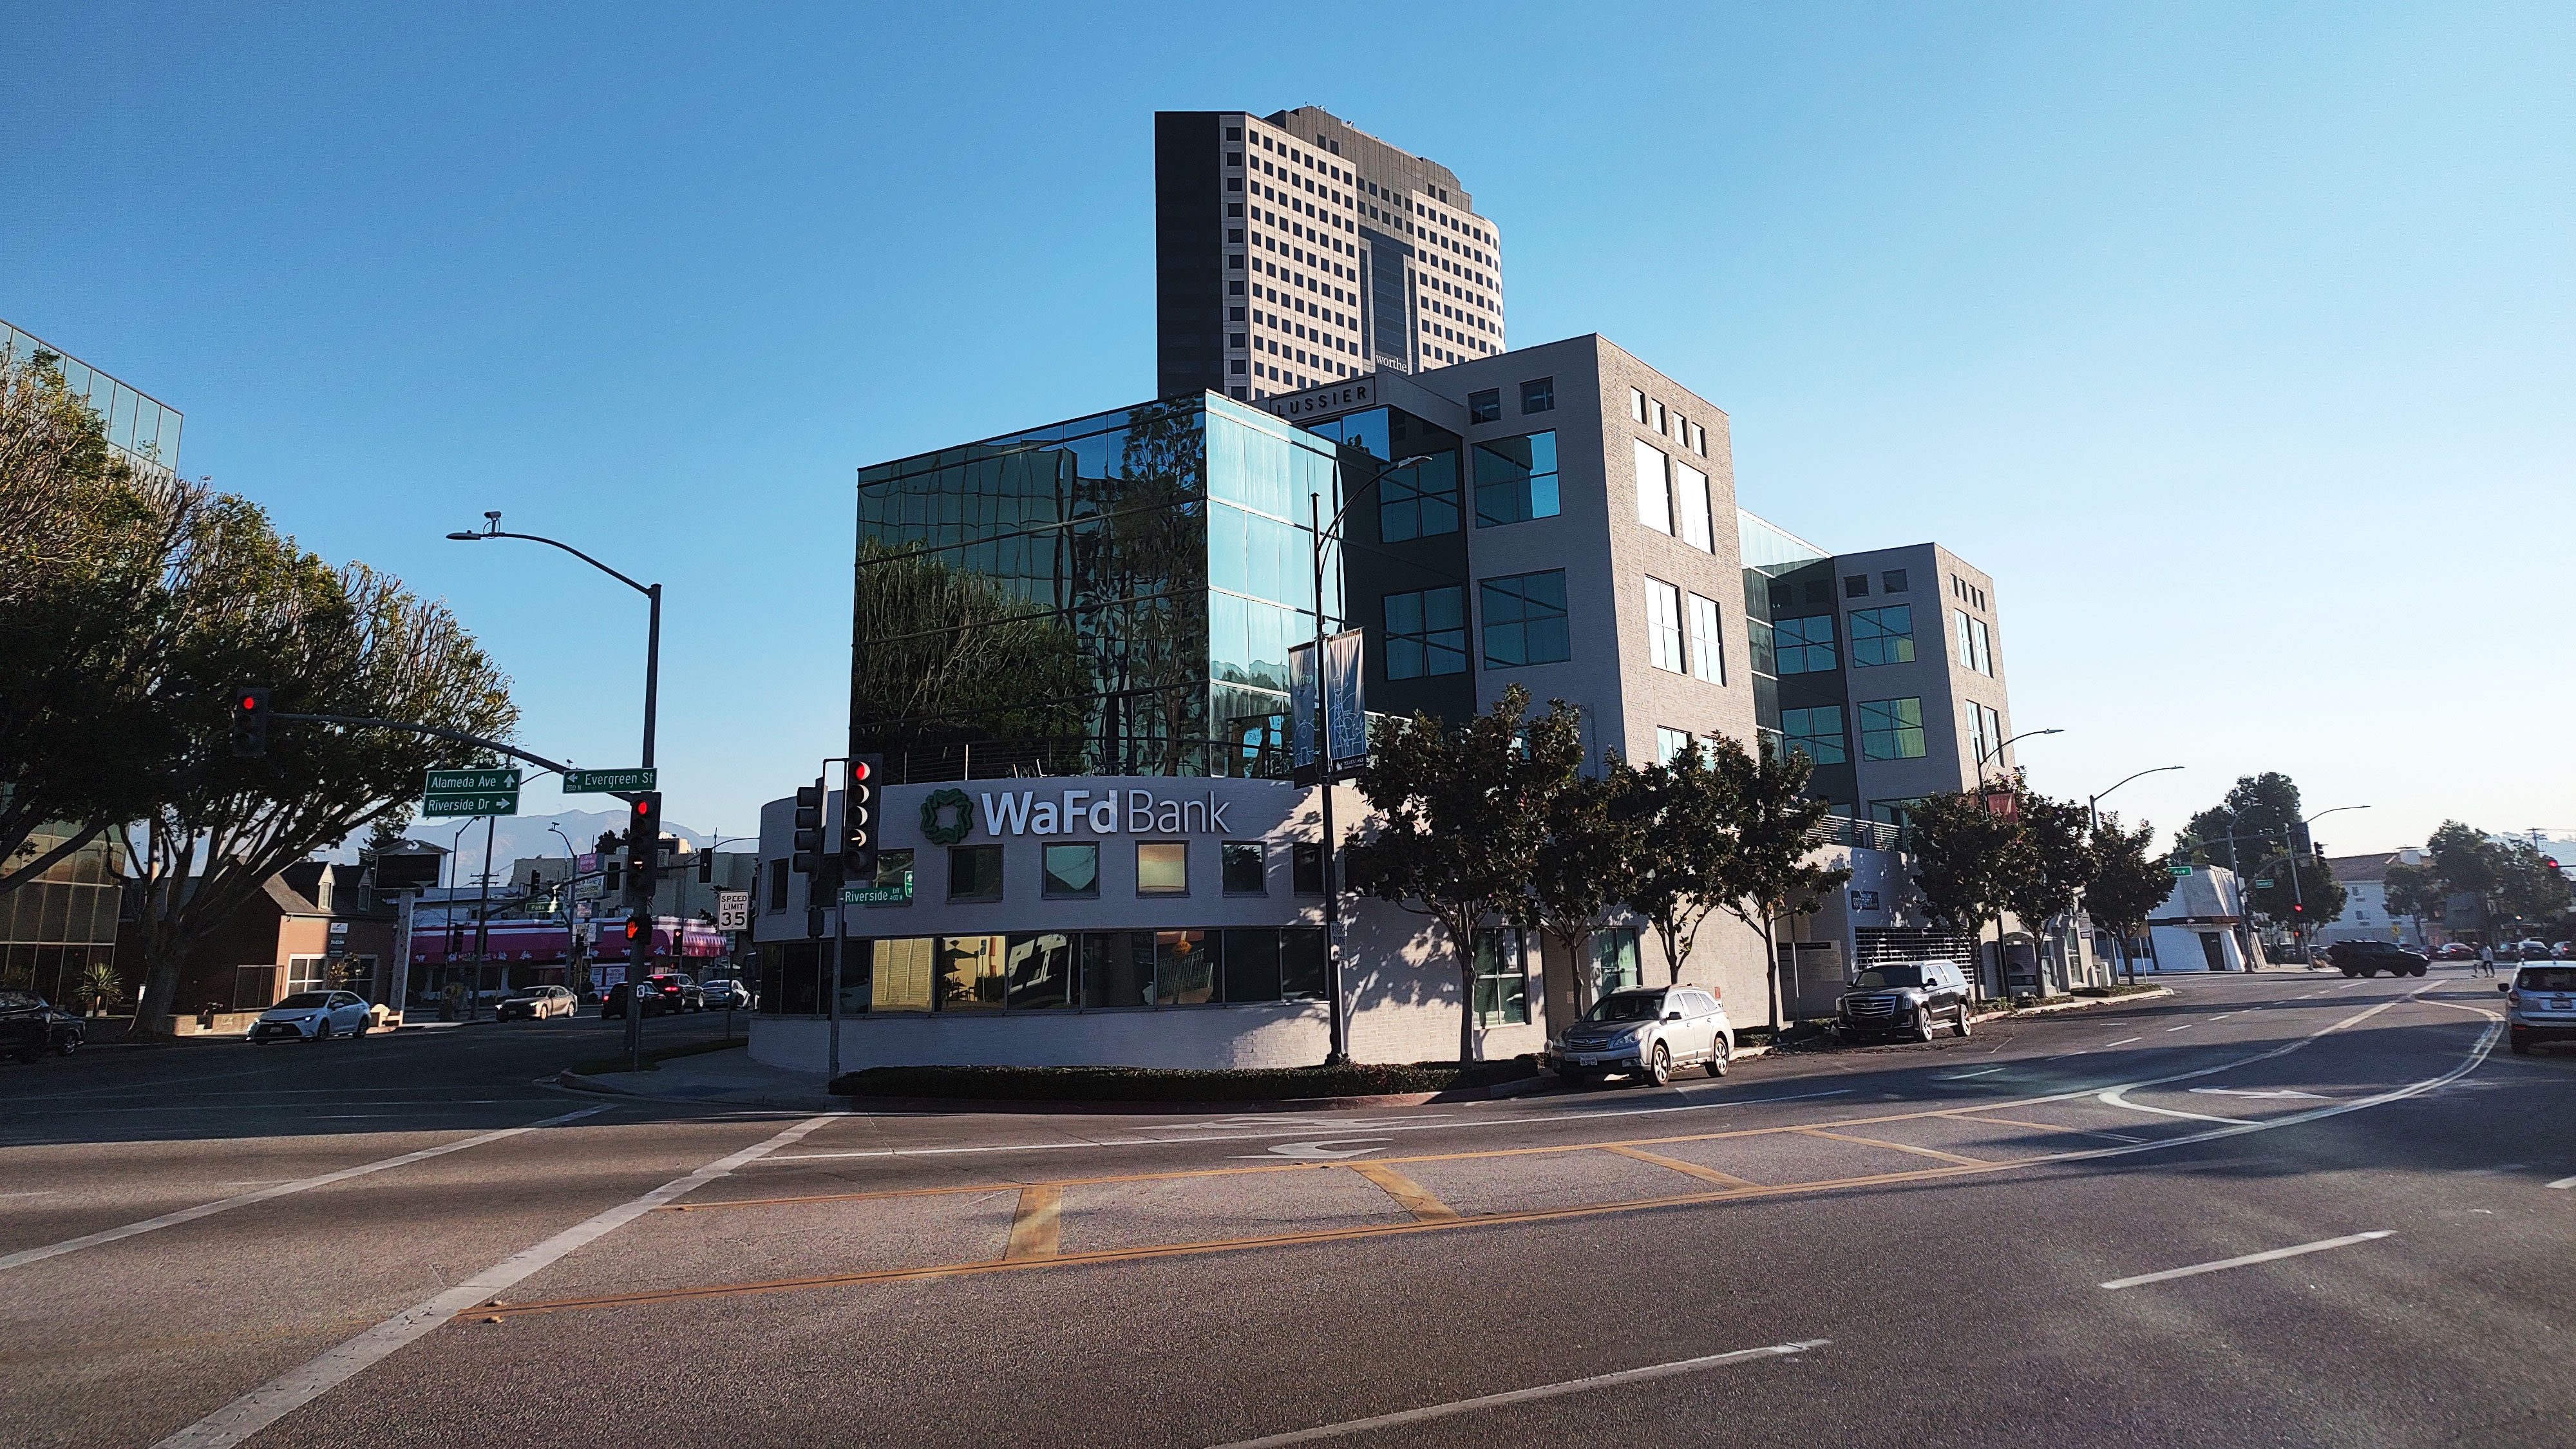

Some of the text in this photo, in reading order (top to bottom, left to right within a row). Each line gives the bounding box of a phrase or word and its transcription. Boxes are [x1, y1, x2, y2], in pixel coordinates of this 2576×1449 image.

[1376, 354, 1407, 373] worthe
[1277, 386, 1367, 417] LUSSIER
[431, 775, 497, 788] Alameda Ave
[585, 772, 654, 788] Evergreen St
[428, 798, 490, 811] Riverside Dr
[981, 789, 1231, 836] WaFd Bank
[845, 890, 888, 902] Riverside
[721, 912, 745, 927] 35
